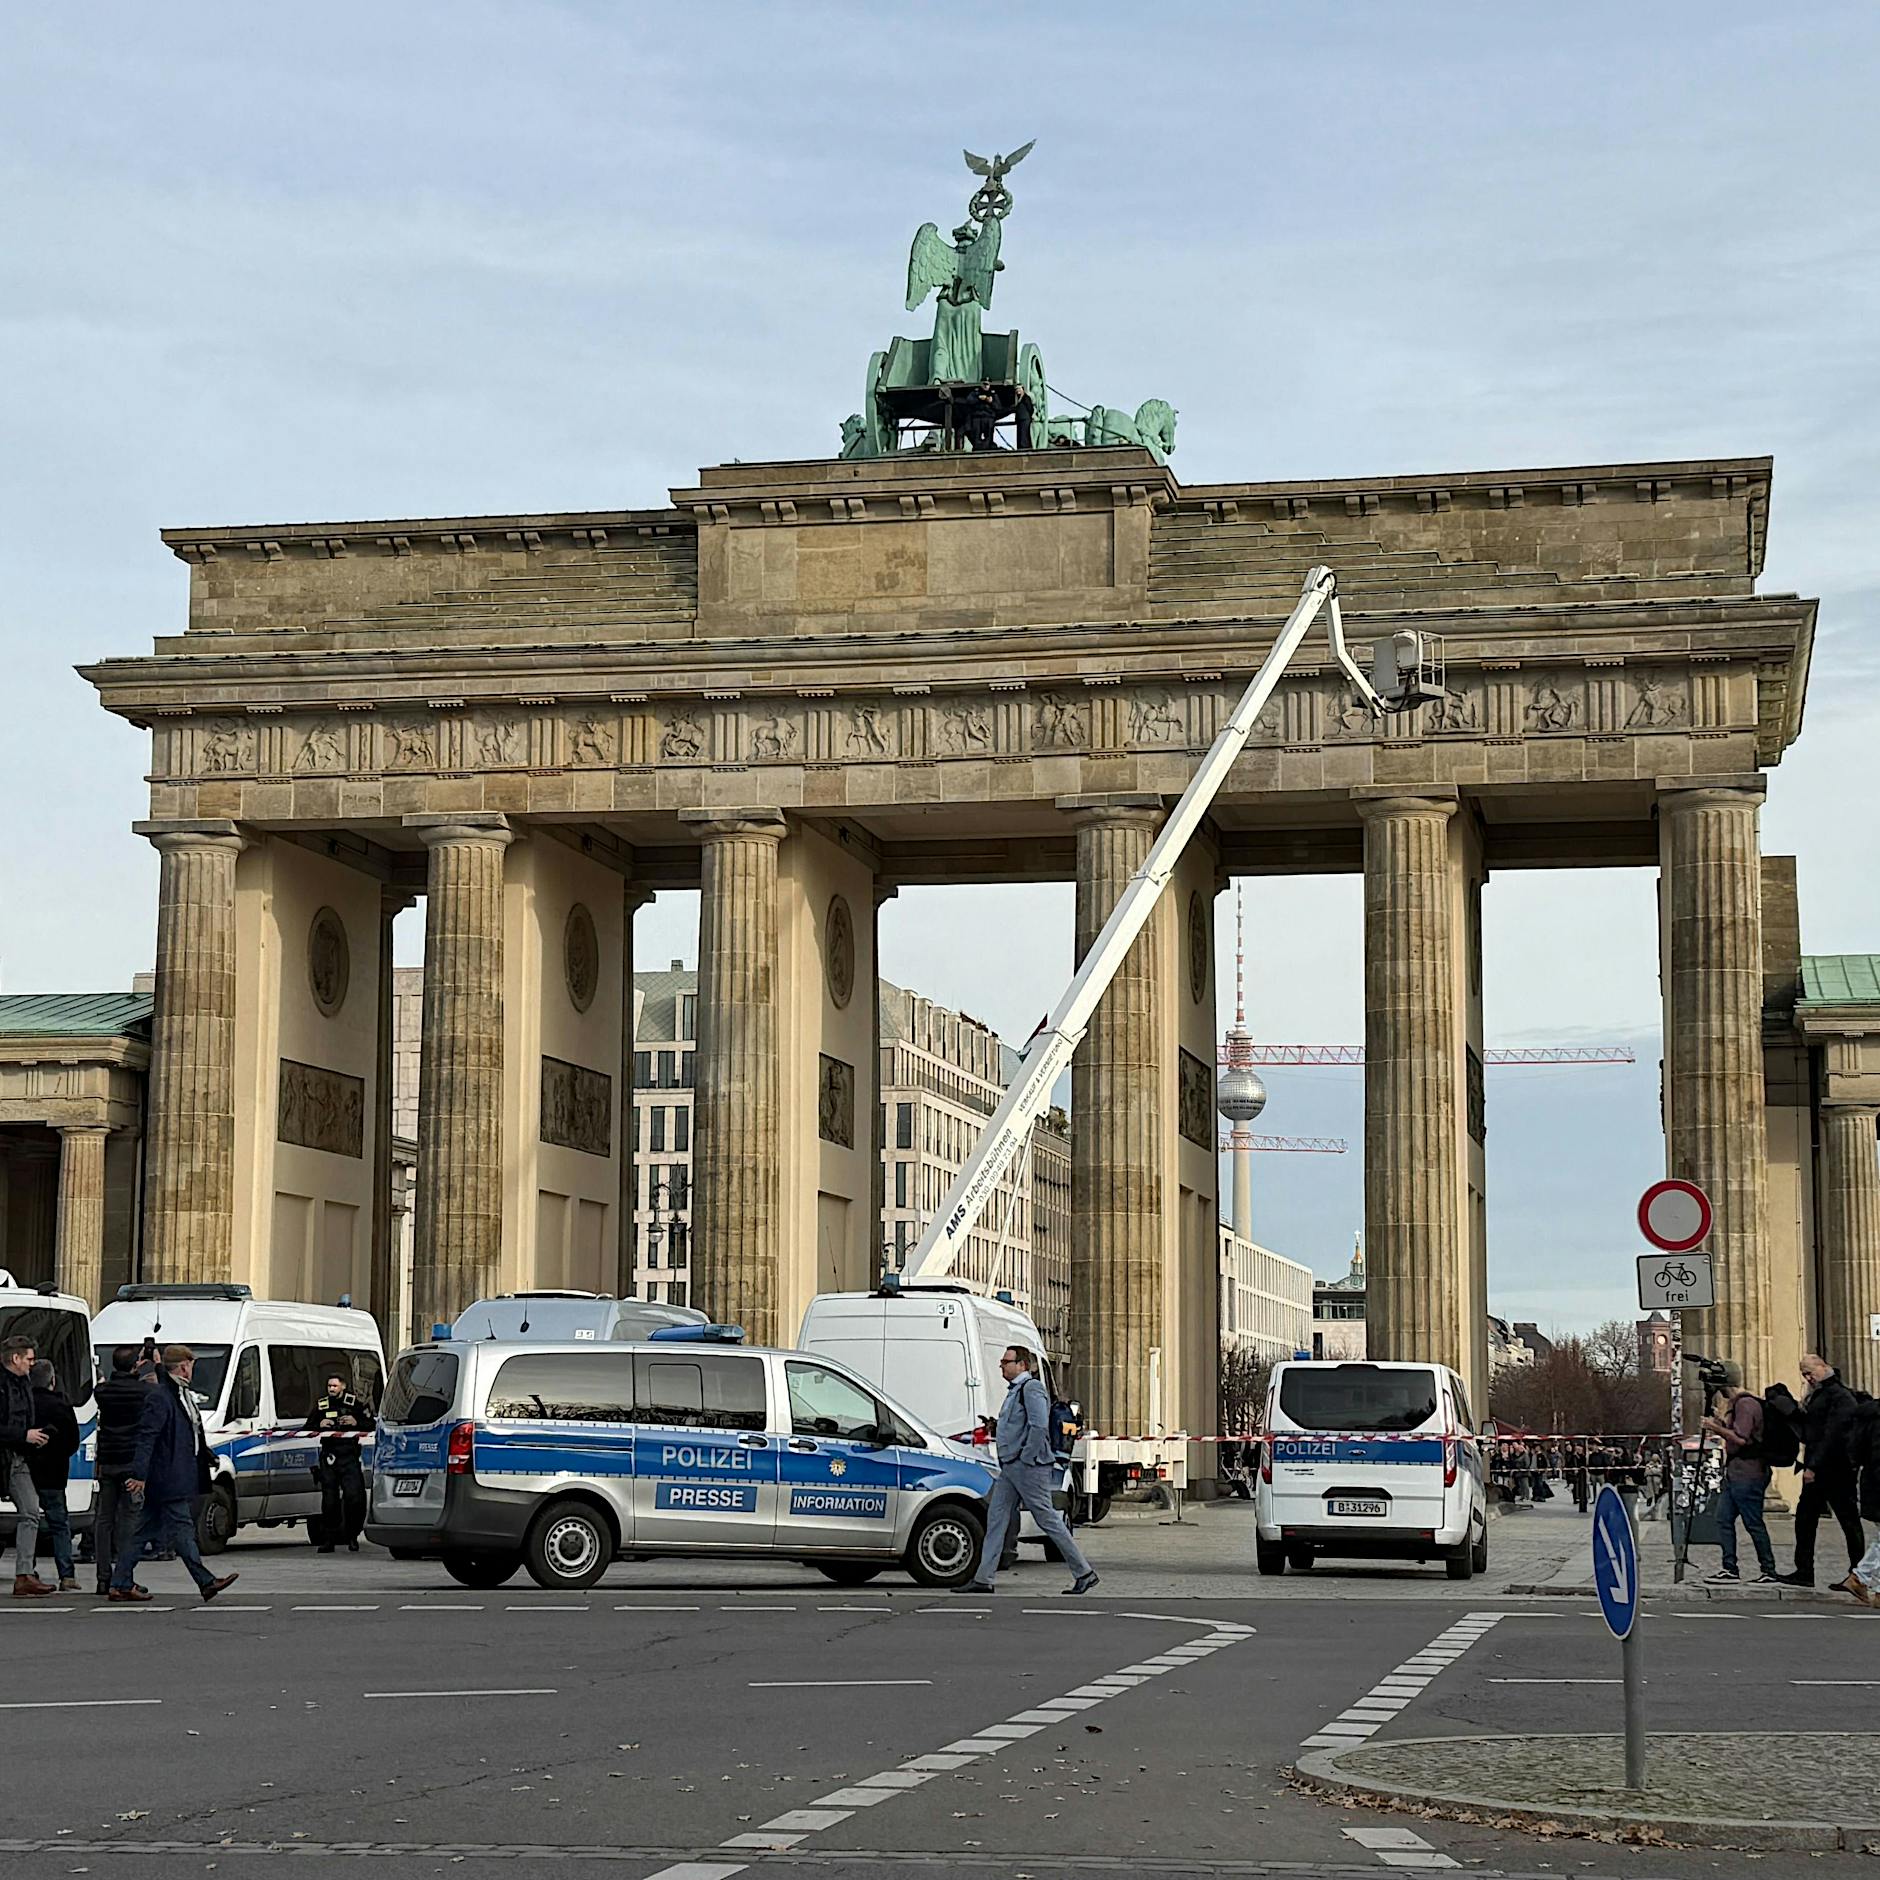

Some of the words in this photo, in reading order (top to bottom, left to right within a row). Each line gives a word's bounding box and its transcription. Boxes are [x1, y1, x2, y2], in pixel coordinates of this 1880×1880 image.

[945, 1204, 966, 1240] AMS
[965, 1128, 1012, 1207] Arbeitsbühnen
[1665, 1289, 1689, 1303] frei
[662, 1446, 752, 1470] POLIZEI
[1276, 1442, 1336, 1456] POLIZEI
[669, 1488, 744, 1508] PRESSE
[793, 1495, 885, 1512] INFORMATION
